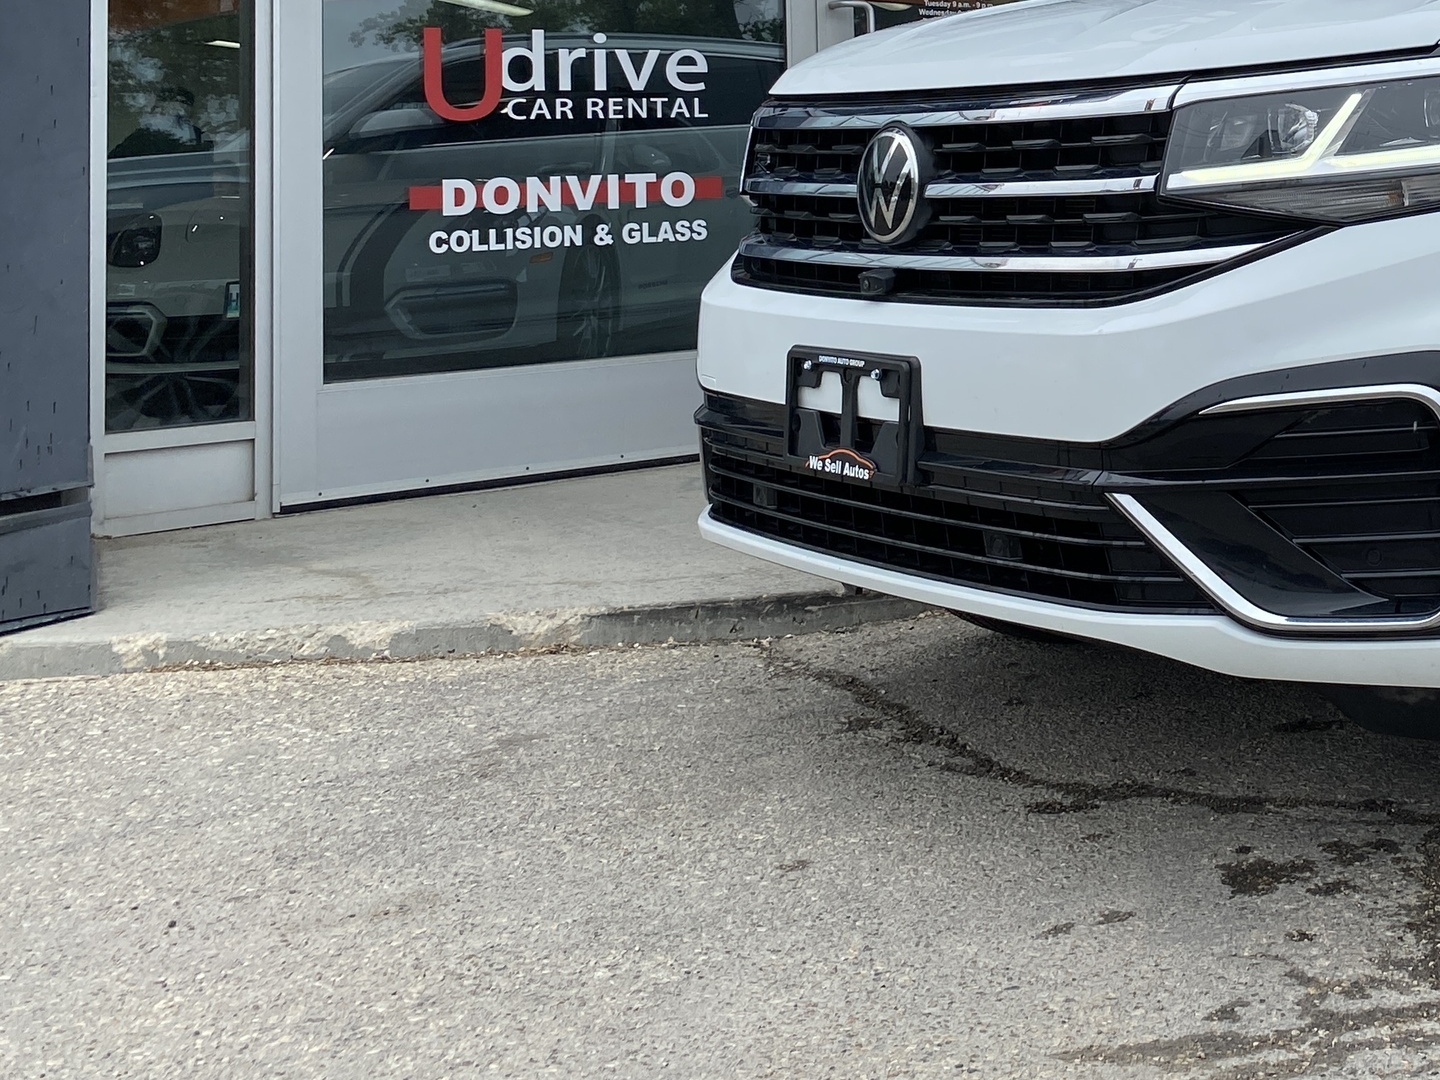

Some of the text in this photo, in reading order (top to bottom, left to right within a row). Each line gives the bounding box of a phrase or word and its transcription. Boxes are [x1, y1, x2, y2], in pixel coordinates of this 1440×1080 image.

[924, 0, 951, 9] Tuesday
[423, 27, 708, 121] Udrive
[505, 98, 708, 120] CAR RENTAL
[441, 171, 696, 217] DONVITO
[428, 219, 708, 255] COLLISION & GLASS
[838, 357, 849, 366] AUTO
[850, 358, 865, 368] GROUP
[809, 455, 870, 480] We Sell Autos
